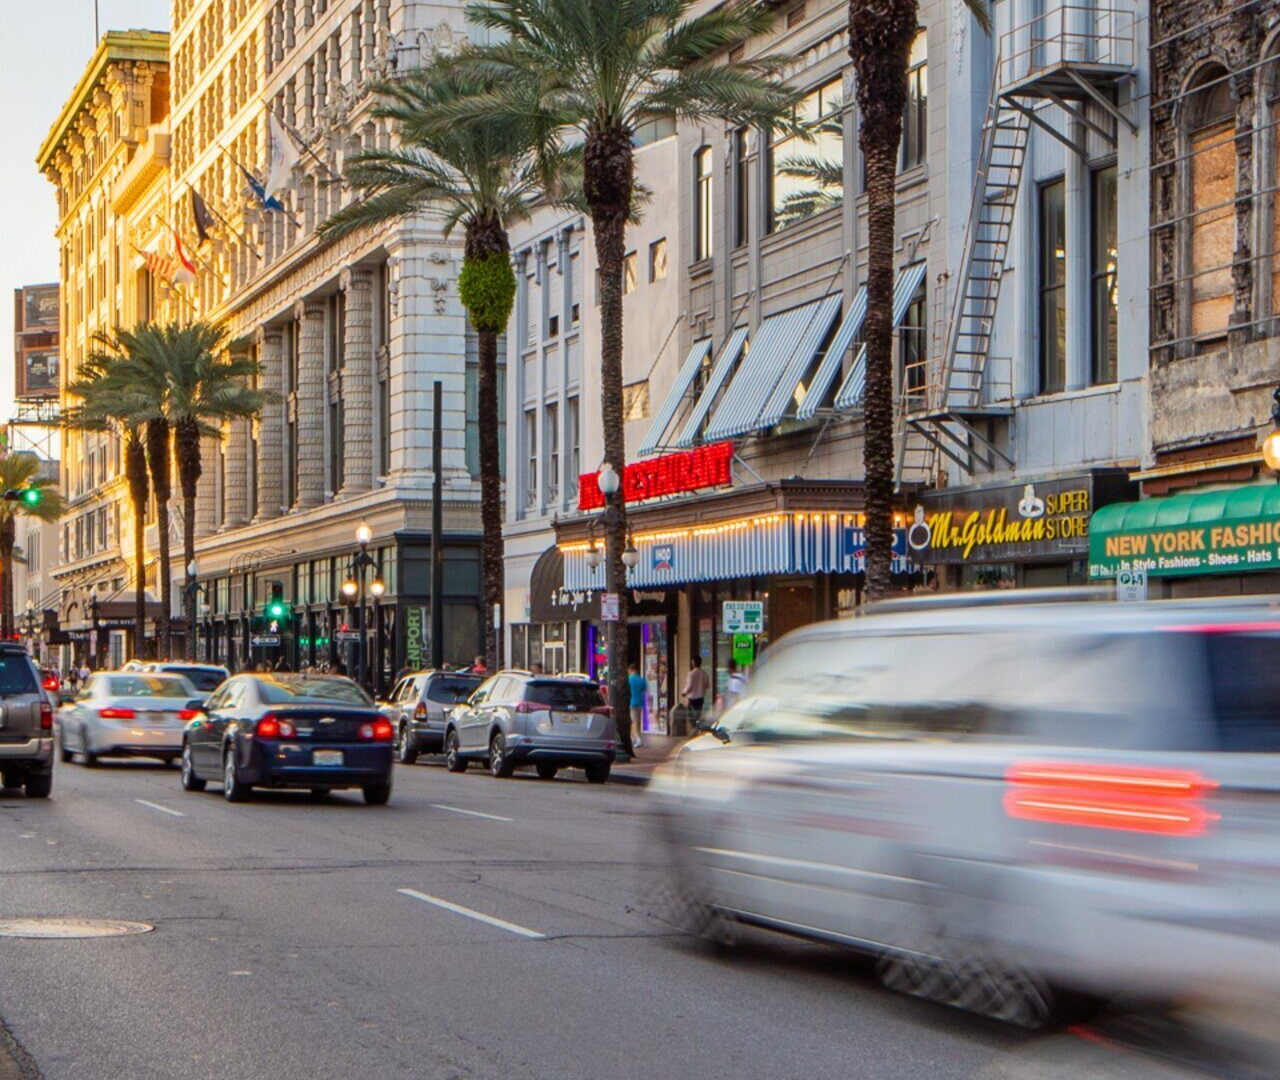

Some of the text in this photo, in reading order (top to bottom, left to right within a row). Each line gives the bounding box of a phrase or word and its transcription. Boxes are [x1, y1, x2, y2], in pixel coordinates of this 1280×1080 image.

[624, 441, 734, 503] ESTAURANT
[1046, 490, 1088, 515] SUPER
[1046, 515, 1088, 539] STORE
[1106, 537, 1147, 557] NEW
[1150, 531, 1205, 554] YORK
[1121, 559, 1131, 570] In
[1133, 556, 1157, 573] Style
[1159, 552, 1200, 569] Fashions
[1209, 550, 1239, 566] Shoes
[1248, 549, 1272, 563] Hats
